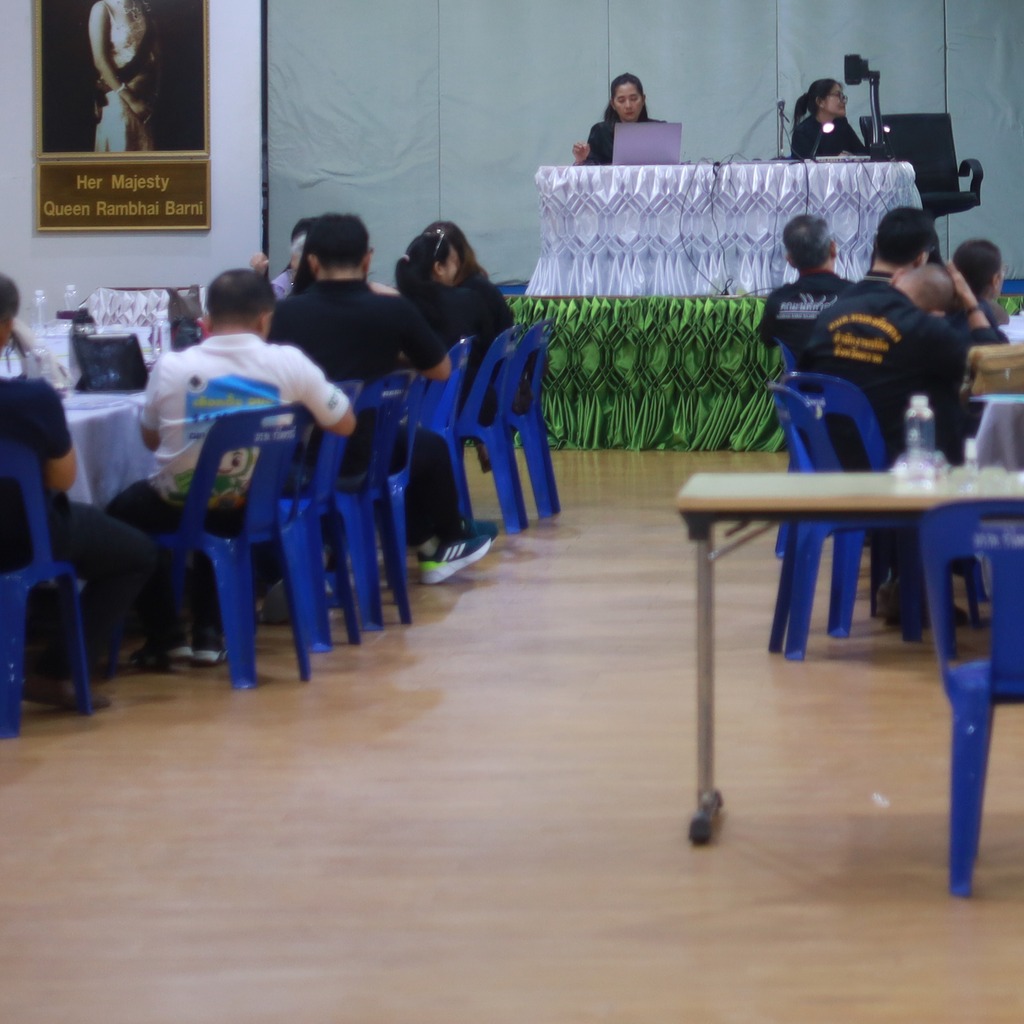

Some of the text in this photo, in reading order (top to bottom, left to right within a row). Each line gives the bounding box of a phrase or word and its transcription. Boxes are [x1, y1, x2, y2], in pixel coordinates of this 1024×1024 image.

[76, 174, 170, 192] Her Majesty
[43, 200, 203, 216] Queen Rambhai Barni
